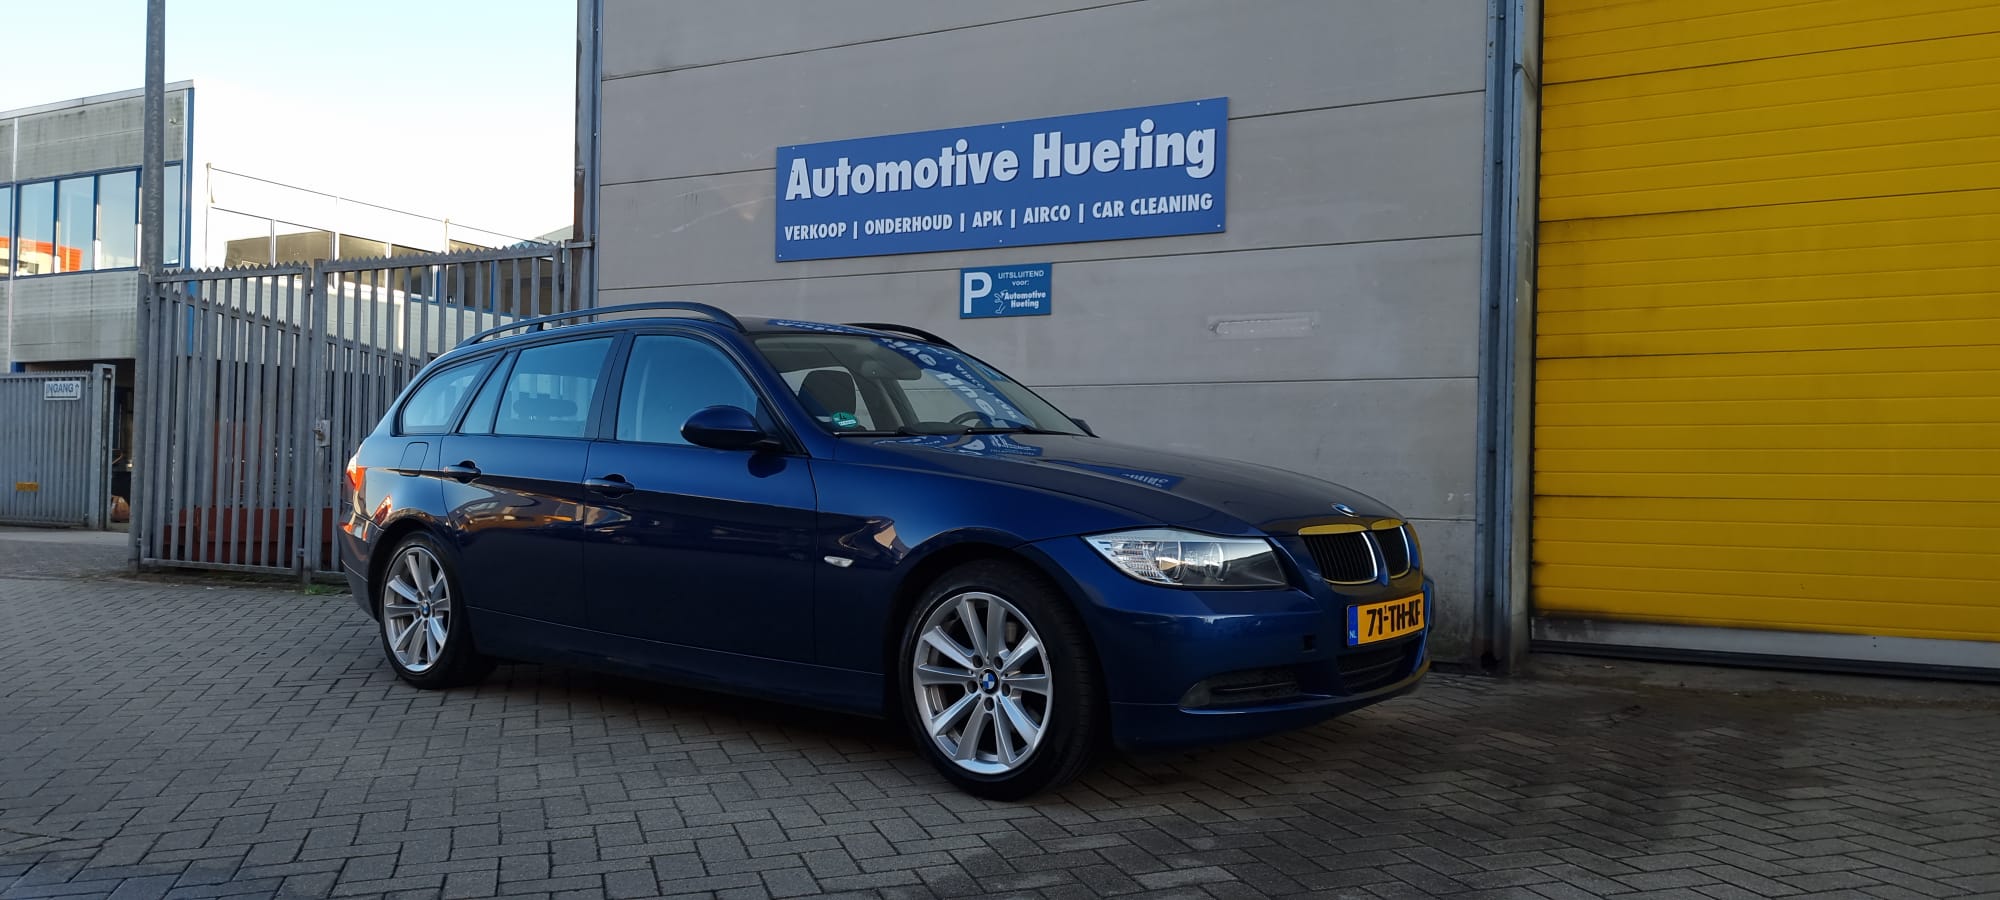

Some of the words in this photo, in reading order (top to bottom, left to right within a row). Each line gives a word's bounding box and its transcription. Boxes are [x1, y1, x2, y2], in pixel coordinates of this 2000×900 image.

[785, 139, 1019, 201] Automotive
[1033, 118, 1216, 179] Hueting
[784, 222, 847, 241] VERKOOP
[864, 214, 953, 235] ONDERHOUD
[972, 209, 1004, 228] APK
[1023, 204, 1071, 225] AIRCO
[1092, 200, 1125, 219] CAR
[1130, 193, 1213, 216] CLEANING
[964, 272, 992, 313] P
[998, 270, 1044, 279] UITSLUITEND
[1004, 290, 1046, 300] Automotive
[1011, 300, 1039, 309] Hueting
[1349, 629, 1358, 639] NL
[1367, 599, 1420, 637] 71-TH-KF
